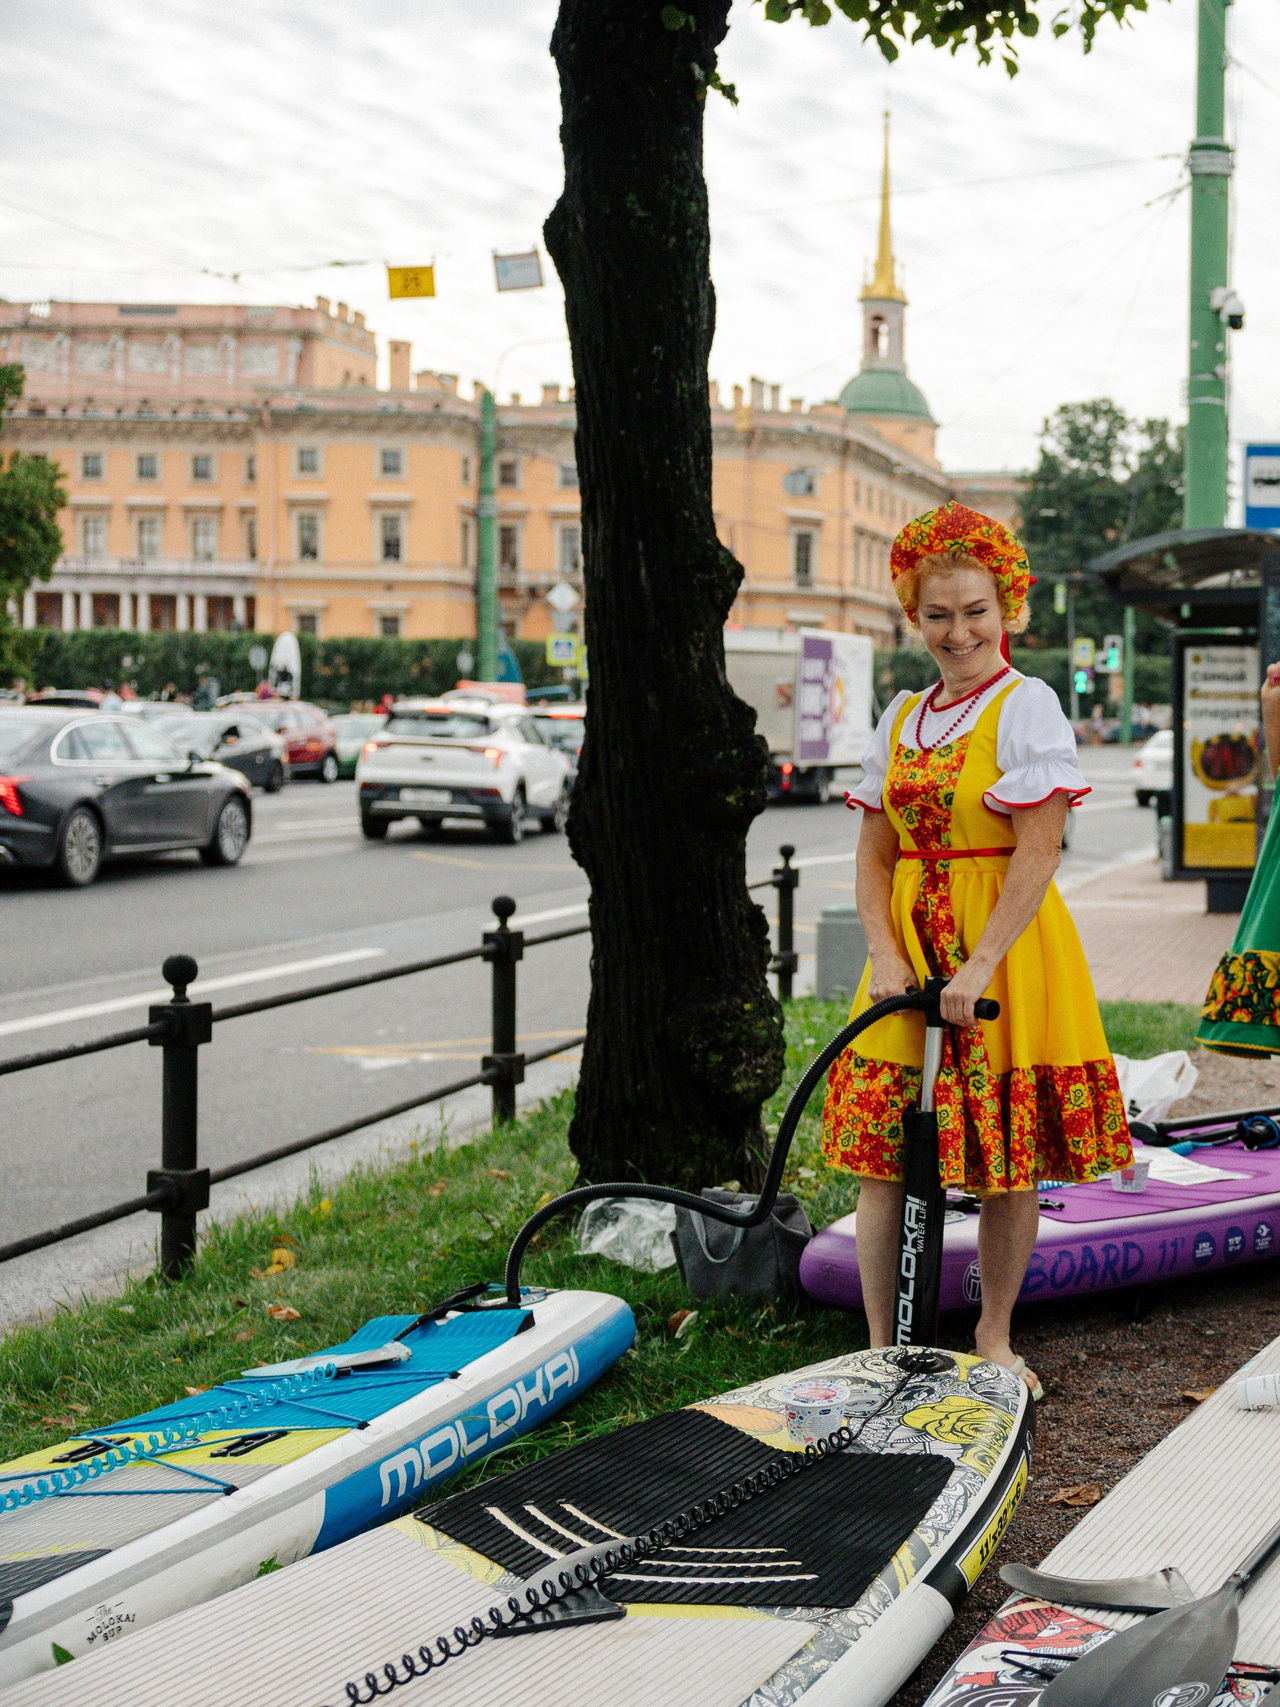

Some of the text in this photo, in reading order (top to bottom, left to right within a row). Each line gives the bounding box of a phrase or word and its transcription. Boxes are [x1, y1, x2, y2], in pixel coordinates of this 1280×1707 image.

[916, 1199, 928, 1253] WATER LIFE
[379, 1346, 580, 1508] MOLOKAI
[85, 1613, 136, 1645] MOLOKAI
[95, 1604, 113, 1623] The
[102, 1625, 122, 1642] SUP
